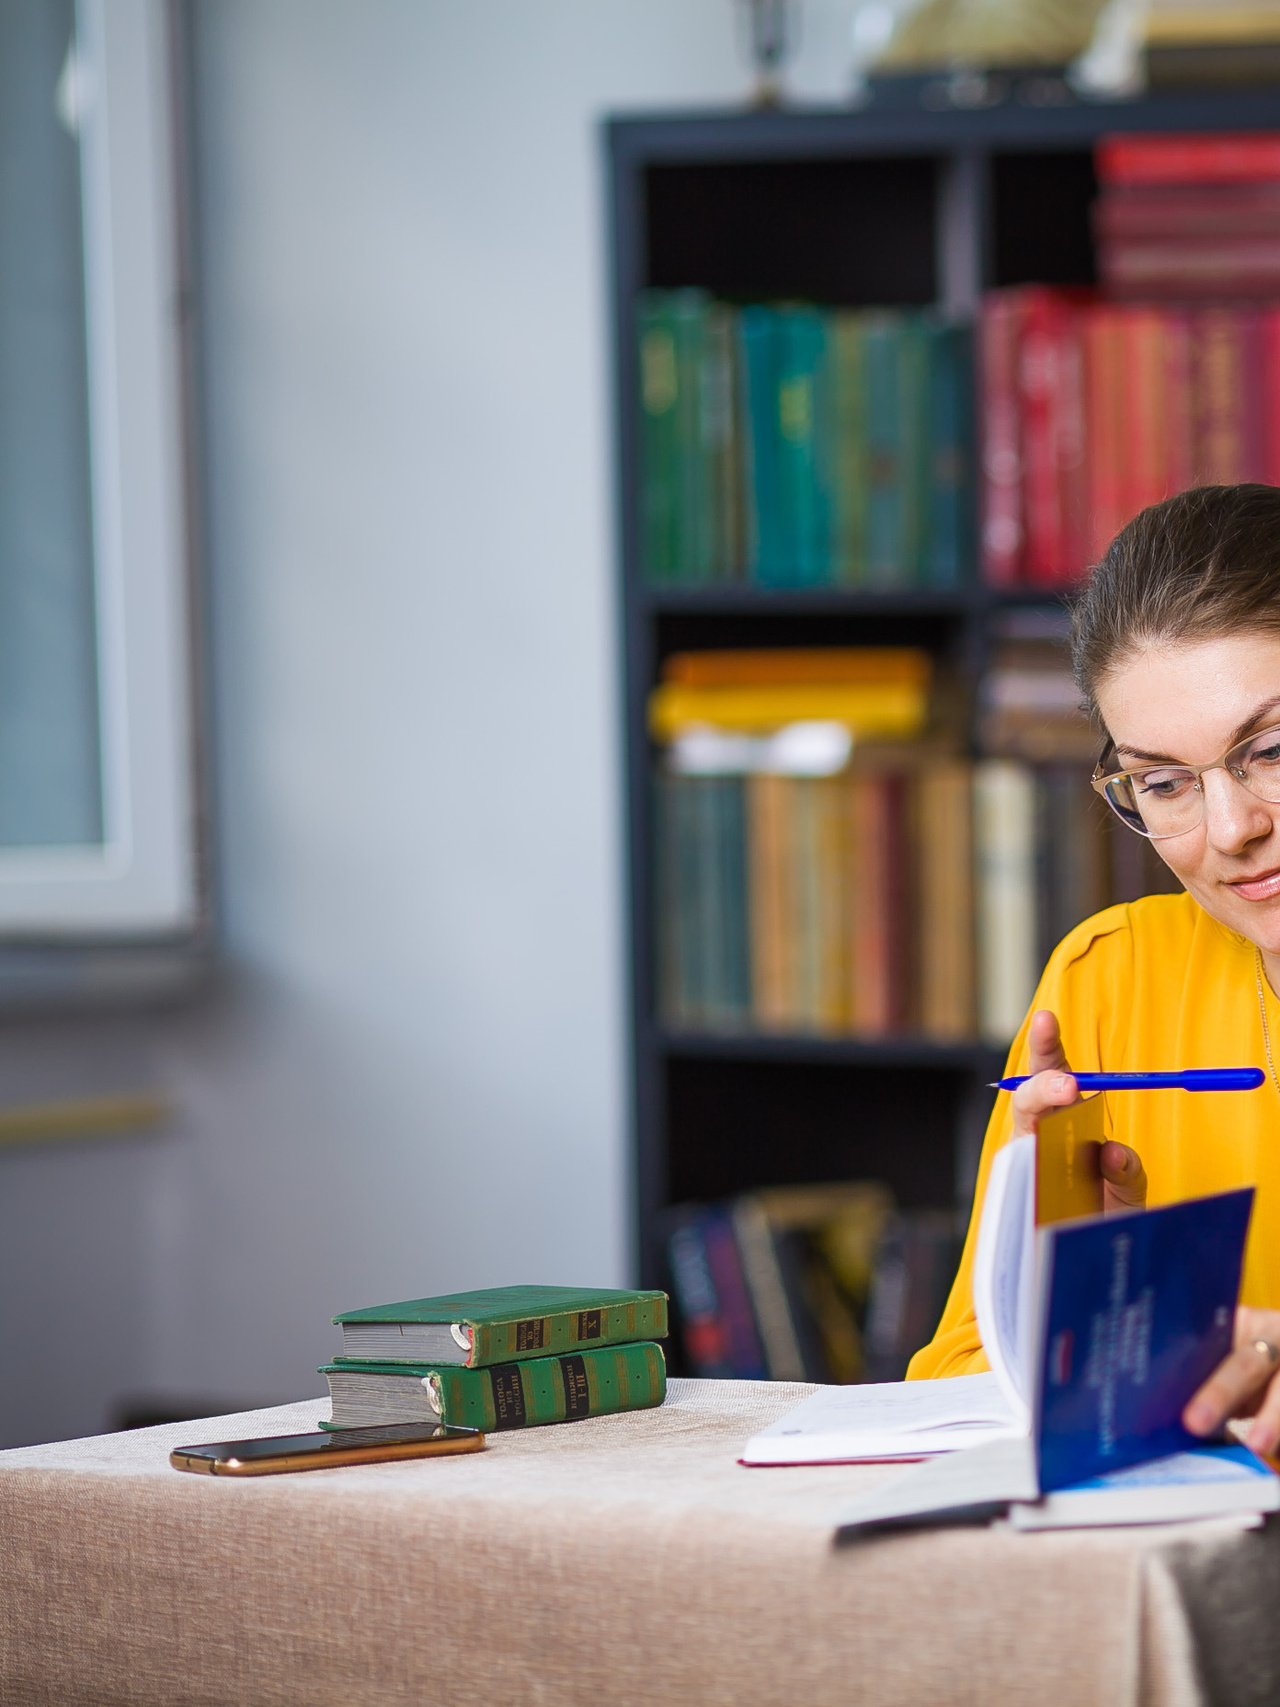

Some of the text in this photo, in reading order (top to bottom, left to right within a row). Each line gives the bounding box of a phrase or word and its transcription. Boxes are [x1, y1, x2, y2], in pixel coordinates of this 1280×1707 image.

[519, 1322, 527, 1350] ГОЛОСА
[532, 1320, 541, 1349] РОССИИ
[588, 1319, 597, 1329] X
[496, 1376, 508, 1419] ГОЛОСА
[506, 1390, 513, 1404] ИЗ
[510, 1374, 522, 1416] РОССИИ
[566, 1364, 577, 1410] КНИЖКИ
